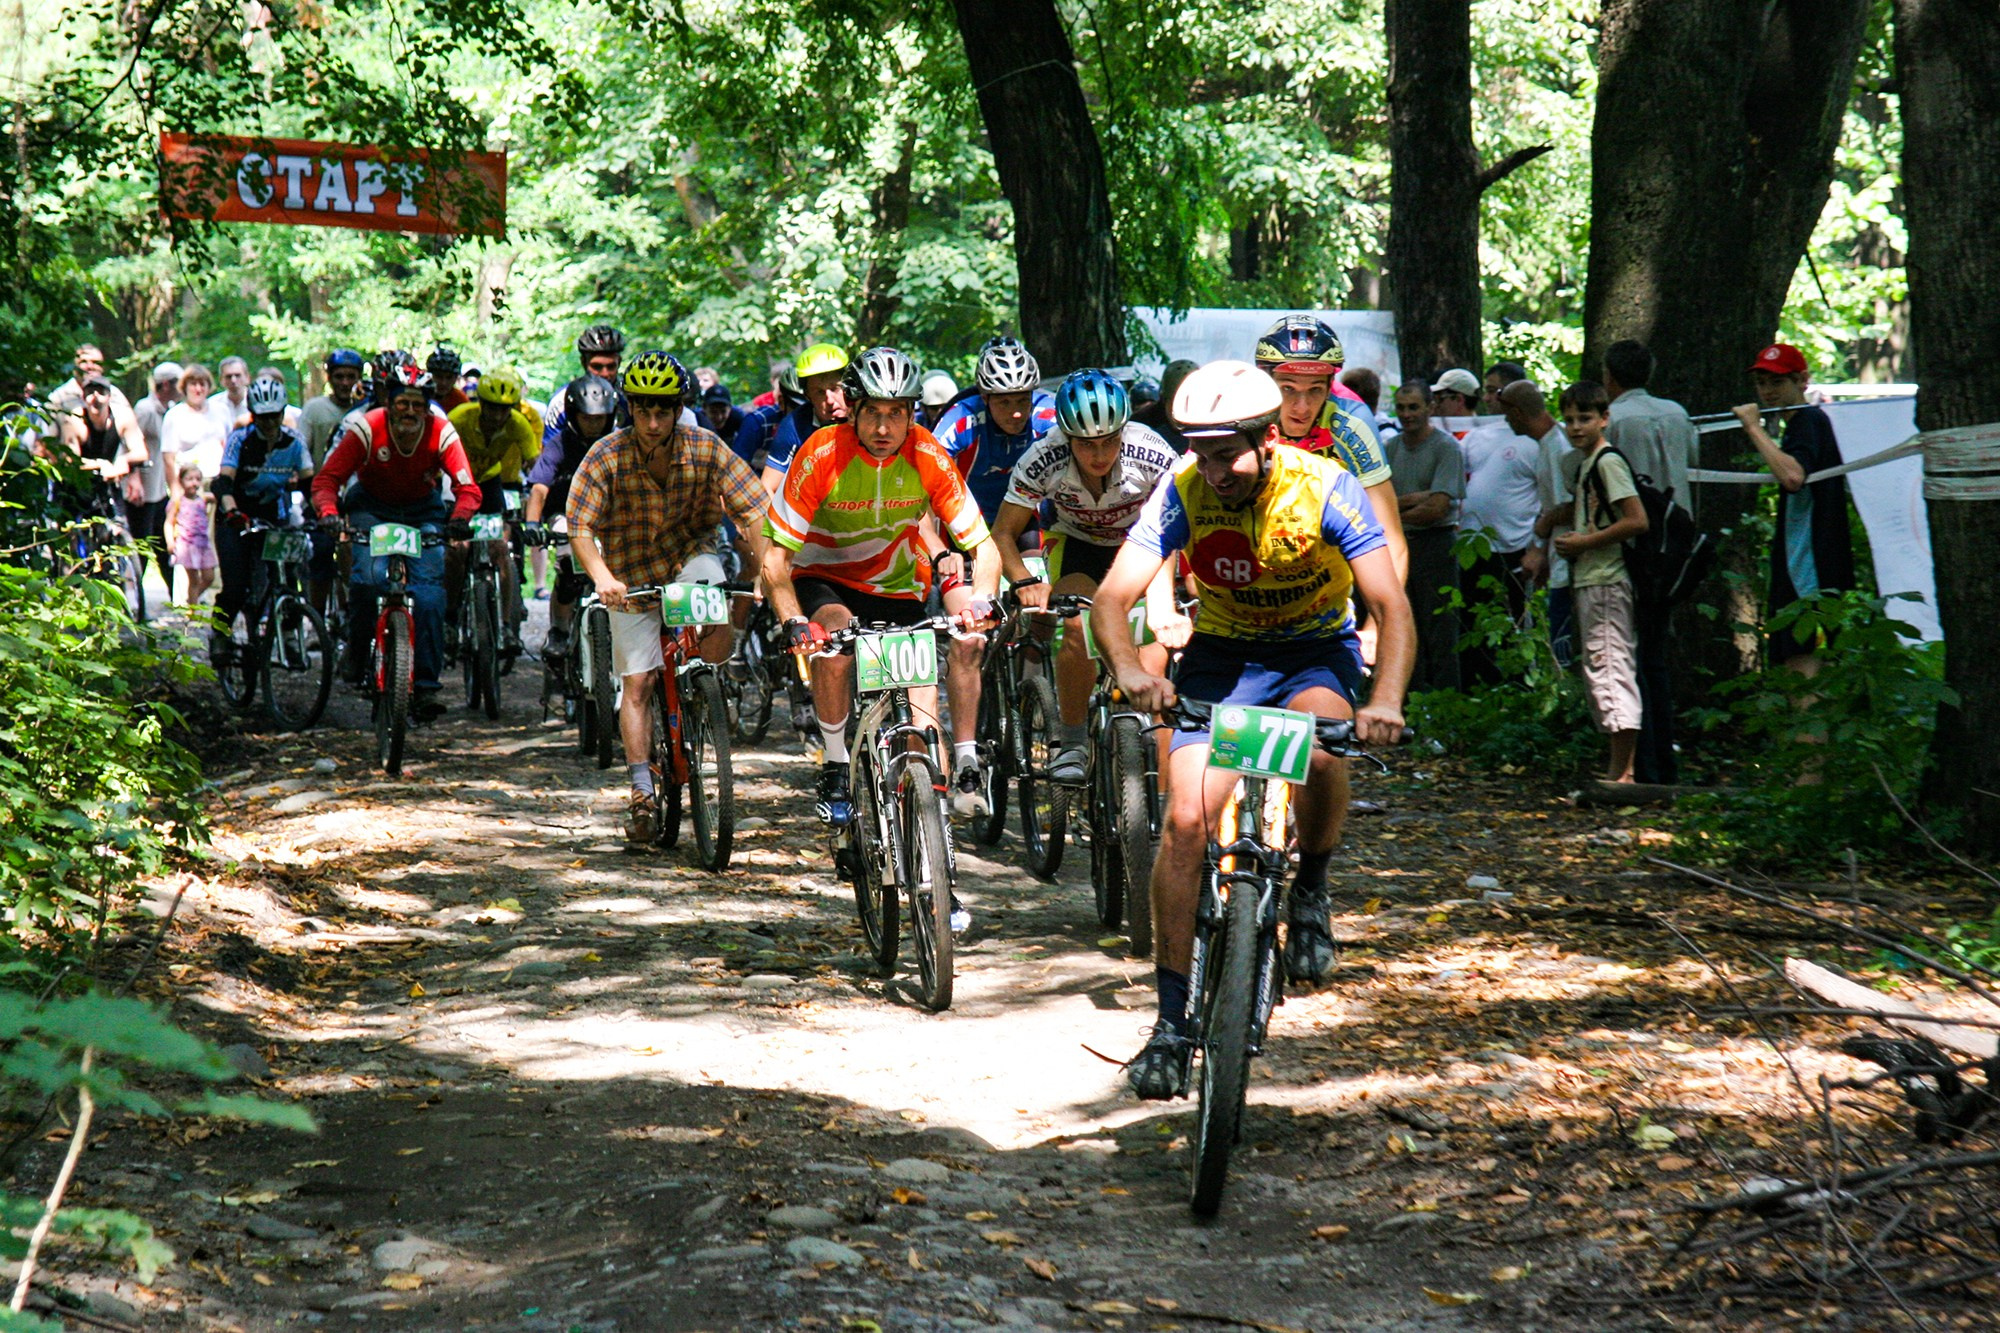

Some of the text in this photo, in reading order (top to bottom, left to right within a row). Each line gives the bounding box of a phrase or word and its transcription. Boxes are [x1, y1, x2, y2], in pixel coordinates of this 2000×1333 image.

[236, 152, 426, 217] СТАРТ
[393, 527, 418, 554] 21
[477, 517, 500, 539] 20
[1214, 557, 1252, 583] GB
[690, 587, 724, 622] 68
[888, 638, 931, 682] 100
[1256, 714, 1309, 774] 77
